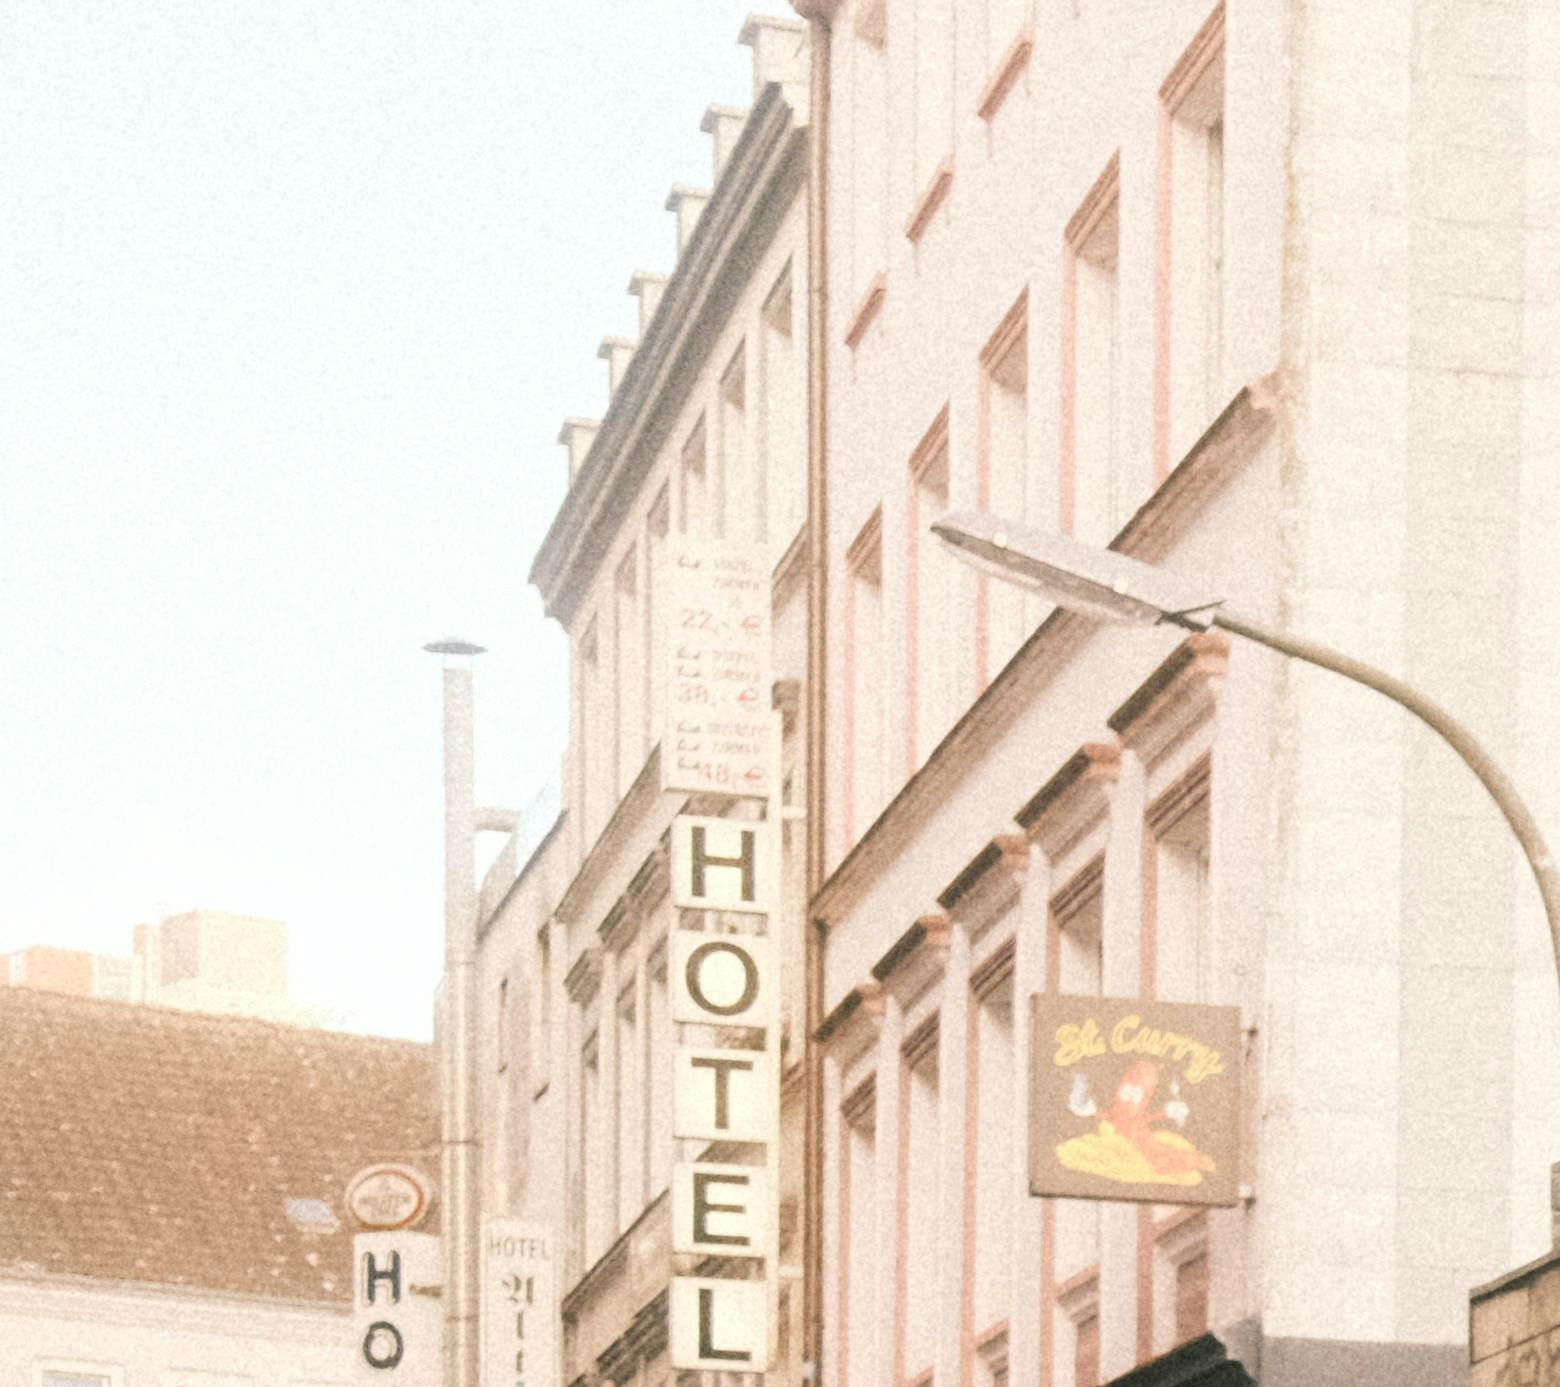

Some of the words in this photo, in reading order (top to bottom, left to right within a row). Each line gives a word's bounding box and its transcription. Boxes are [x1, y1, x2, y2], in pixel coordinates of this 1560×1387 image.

[1111, 1013, 1224, 1085] Curry
[685, 825, 762, 1362] HOTEL
[489, 1237, 552, 1262] HOTEL
